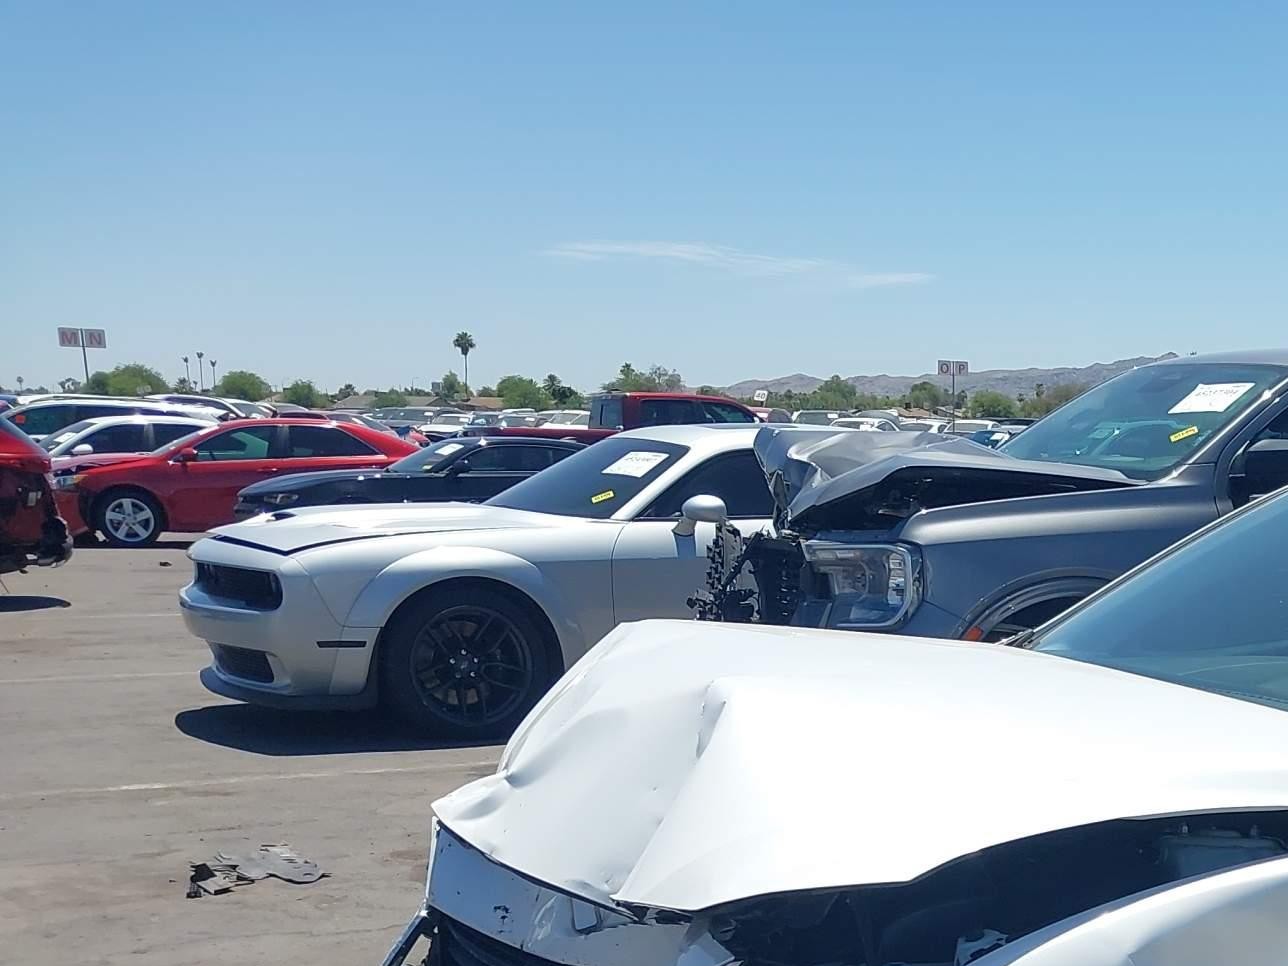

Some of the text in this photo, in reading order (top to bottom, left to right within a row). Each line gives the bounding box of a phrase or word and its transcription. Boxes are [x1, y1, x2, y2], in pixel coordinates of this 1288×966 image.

[61, 330, 102, 345] M N
[958, 364, 966, 375] P
[755, 392, 766, 400] 40
